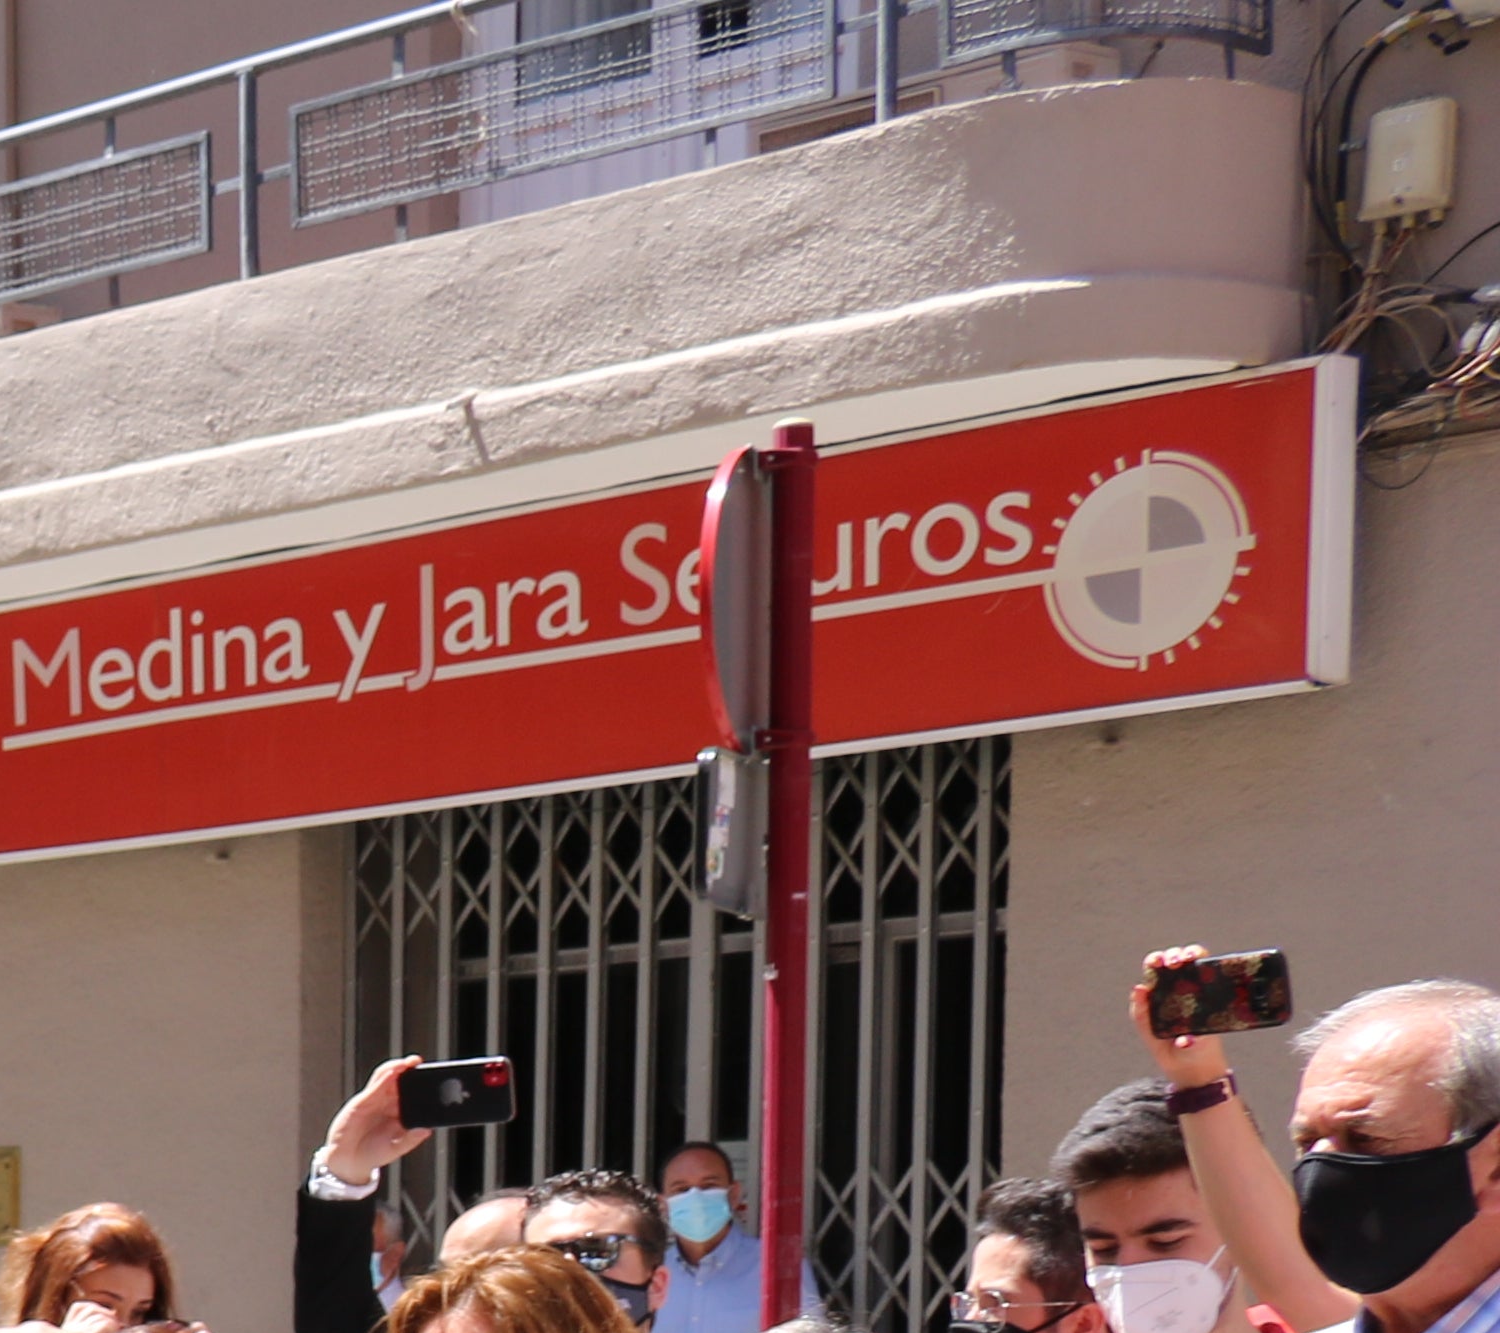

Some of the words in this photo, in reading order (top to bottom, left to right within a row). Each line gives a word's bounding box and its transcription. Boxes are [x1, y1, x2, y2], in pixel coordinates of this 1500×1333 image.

[11, 607, 310, 726] Medina
[333, 602, 386, 702] y
[405, 564, 589, 692] Jara
[619, 491, 1034, 627] Seuros
